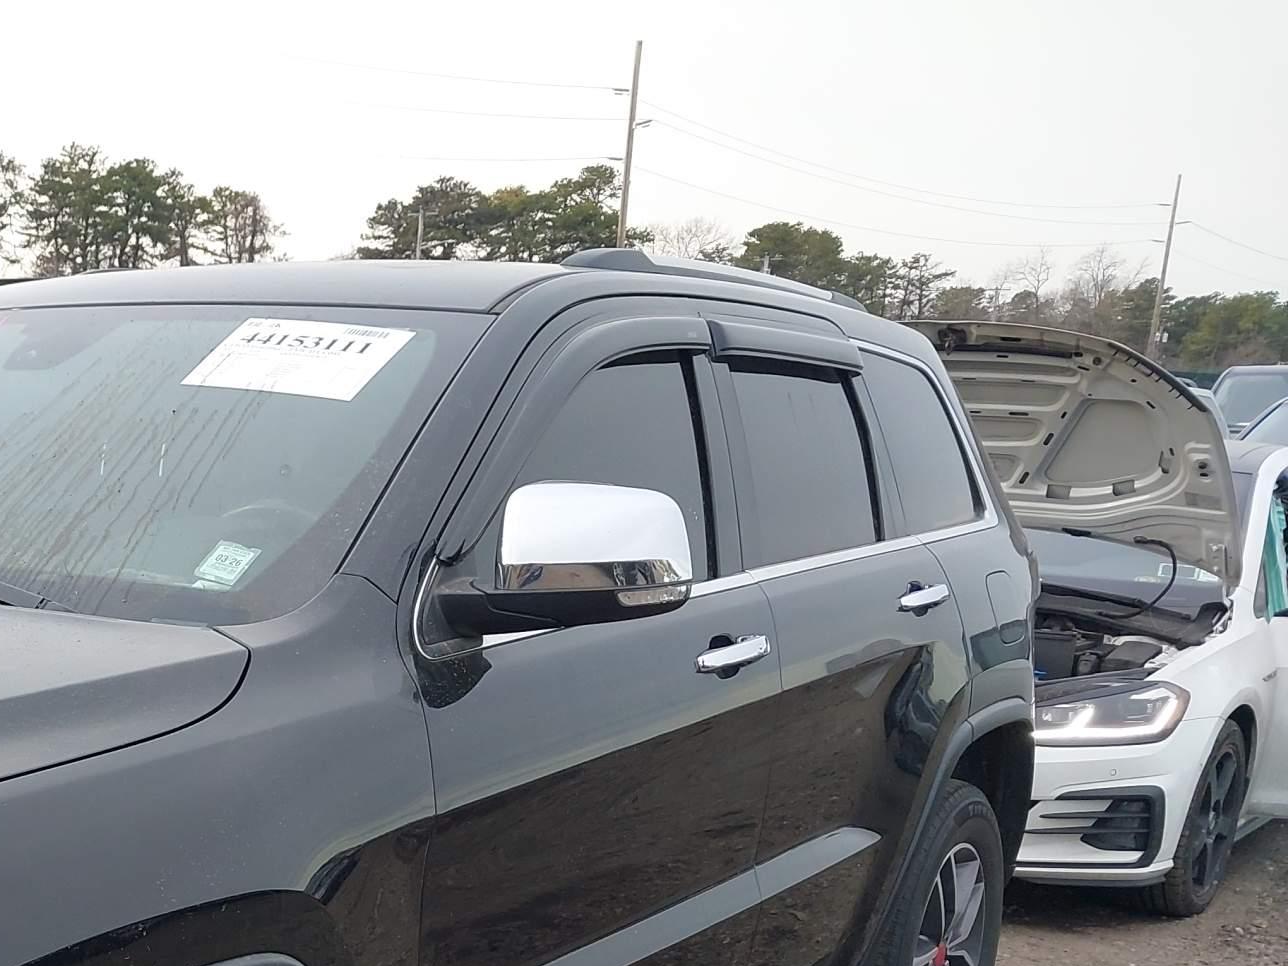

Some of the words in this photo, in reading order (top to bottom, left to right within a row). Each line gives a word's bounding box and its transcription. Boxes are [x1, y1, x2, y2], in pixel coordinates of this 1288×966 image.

[240, 331, 373, 354] 44153111
[215, 553, 229, 563] 03
[229, 559, 243, 567] 26
